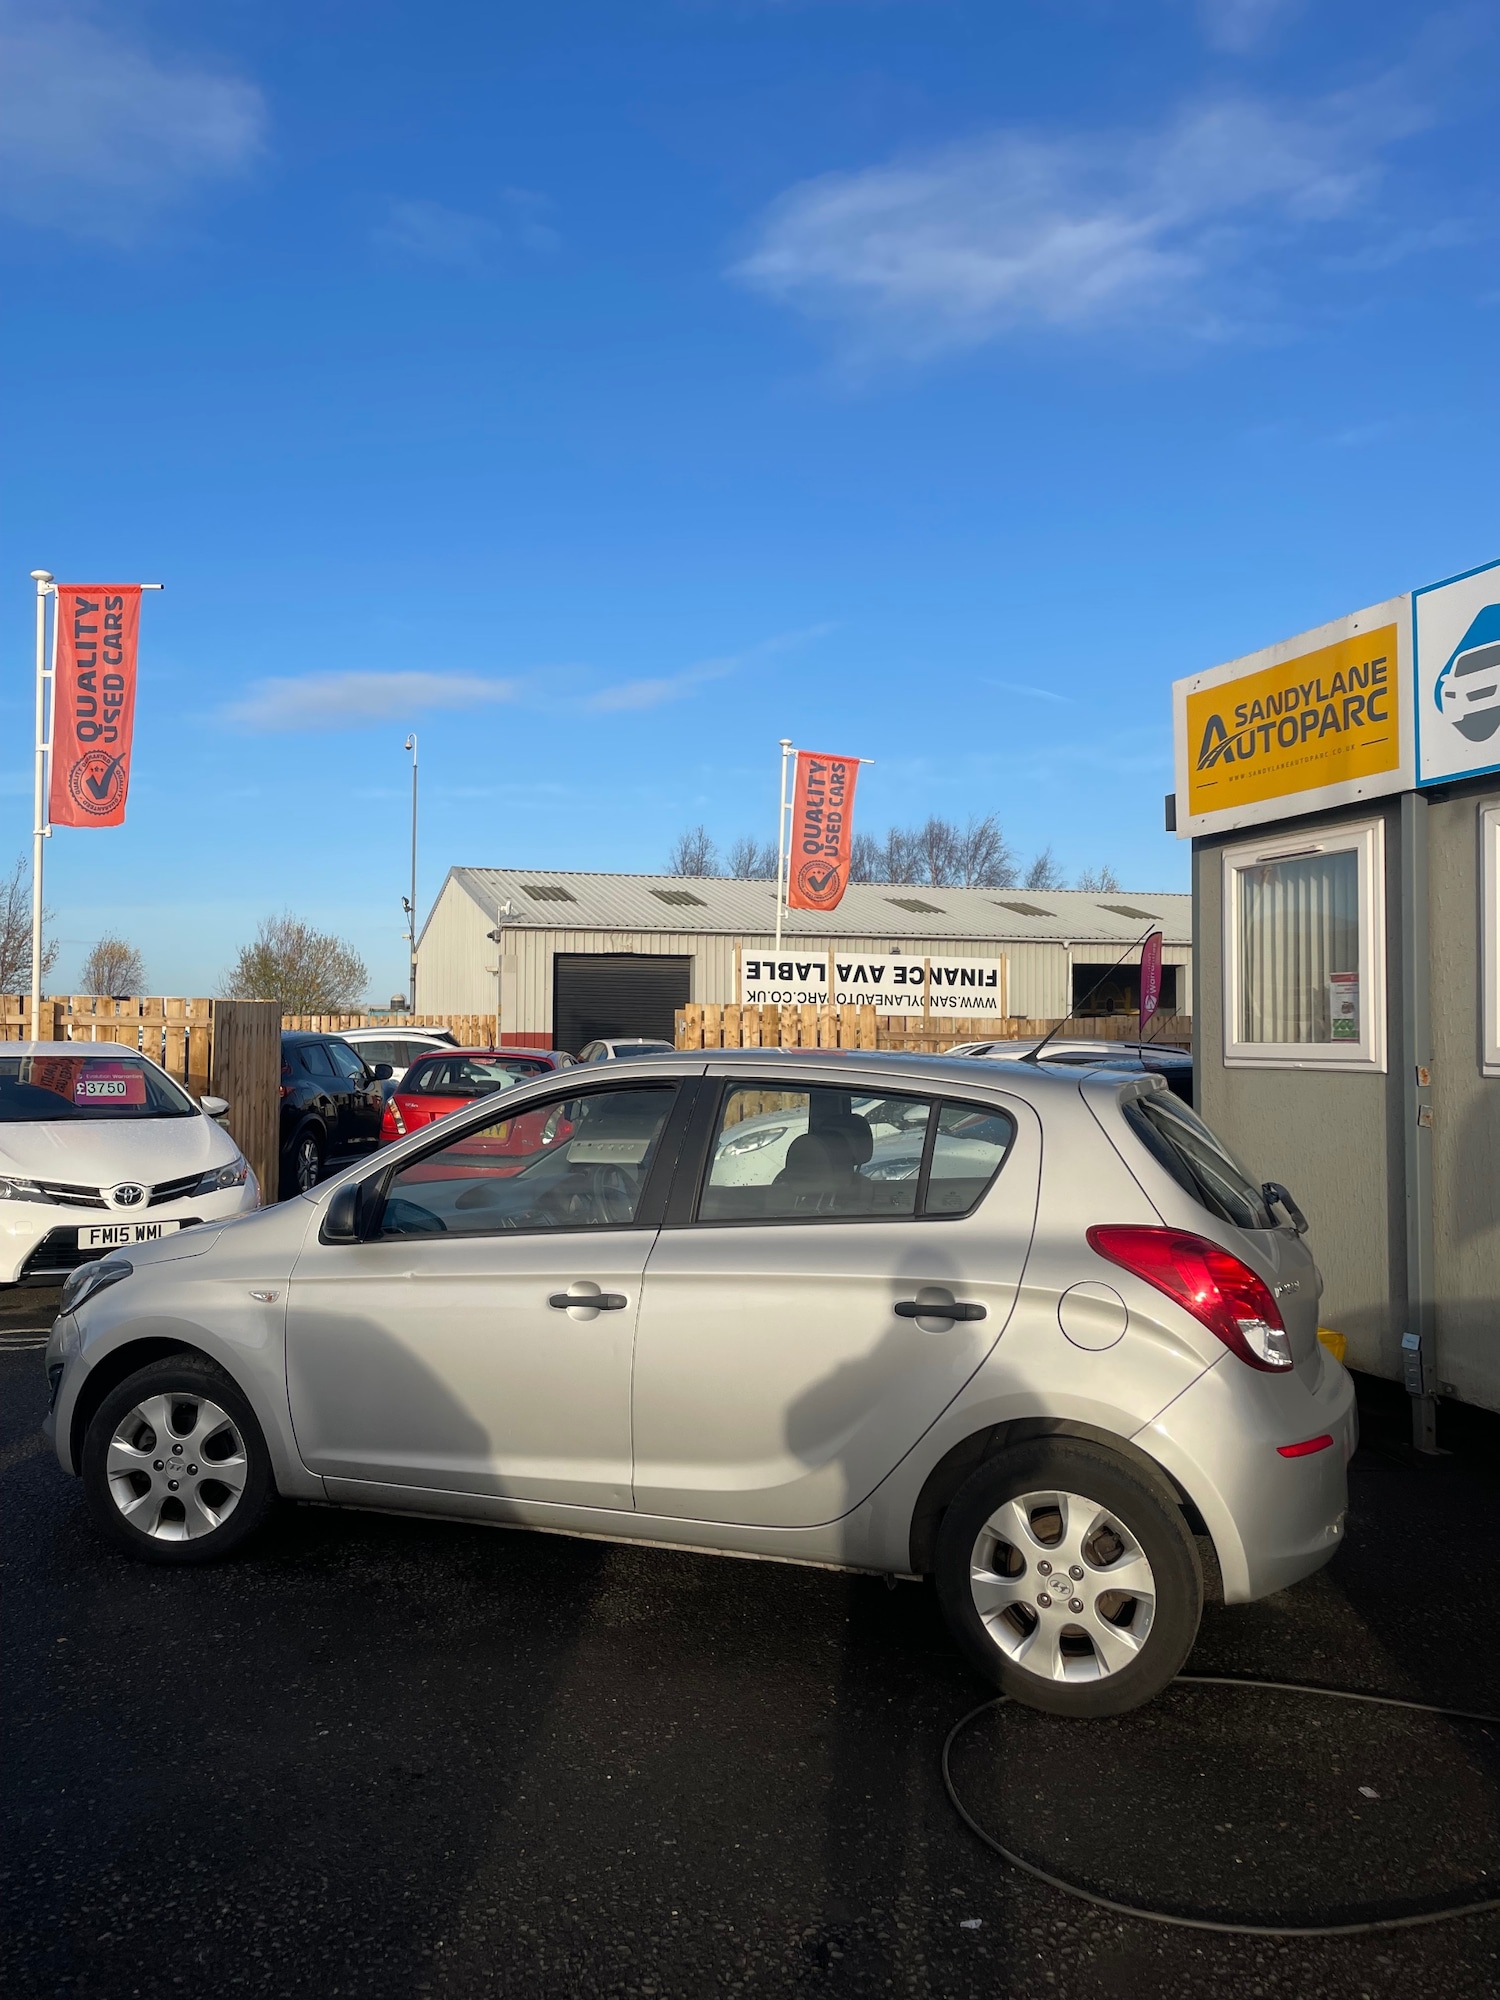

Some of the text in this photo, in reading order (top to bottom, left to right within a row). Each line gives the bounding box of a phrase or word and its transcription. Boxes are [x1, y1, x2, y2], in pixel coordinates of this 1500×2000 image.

[75, 596, 103, 742] QUALITY
[103, 595, 124, 743] USED CARS
[1235, 656, 1387, 728] SANDYLANE
[1196, 686, 1388, 771] AUTOPARC
[803, 759, 827, 855] QUALITY
[824, 762, 846, 857] USED CARS
[746, 961, 998, 988] FINANCE AVALABLE
[76, 1082, 125, 1095] £3750
[90, 1226, 130, 1245] FM15
